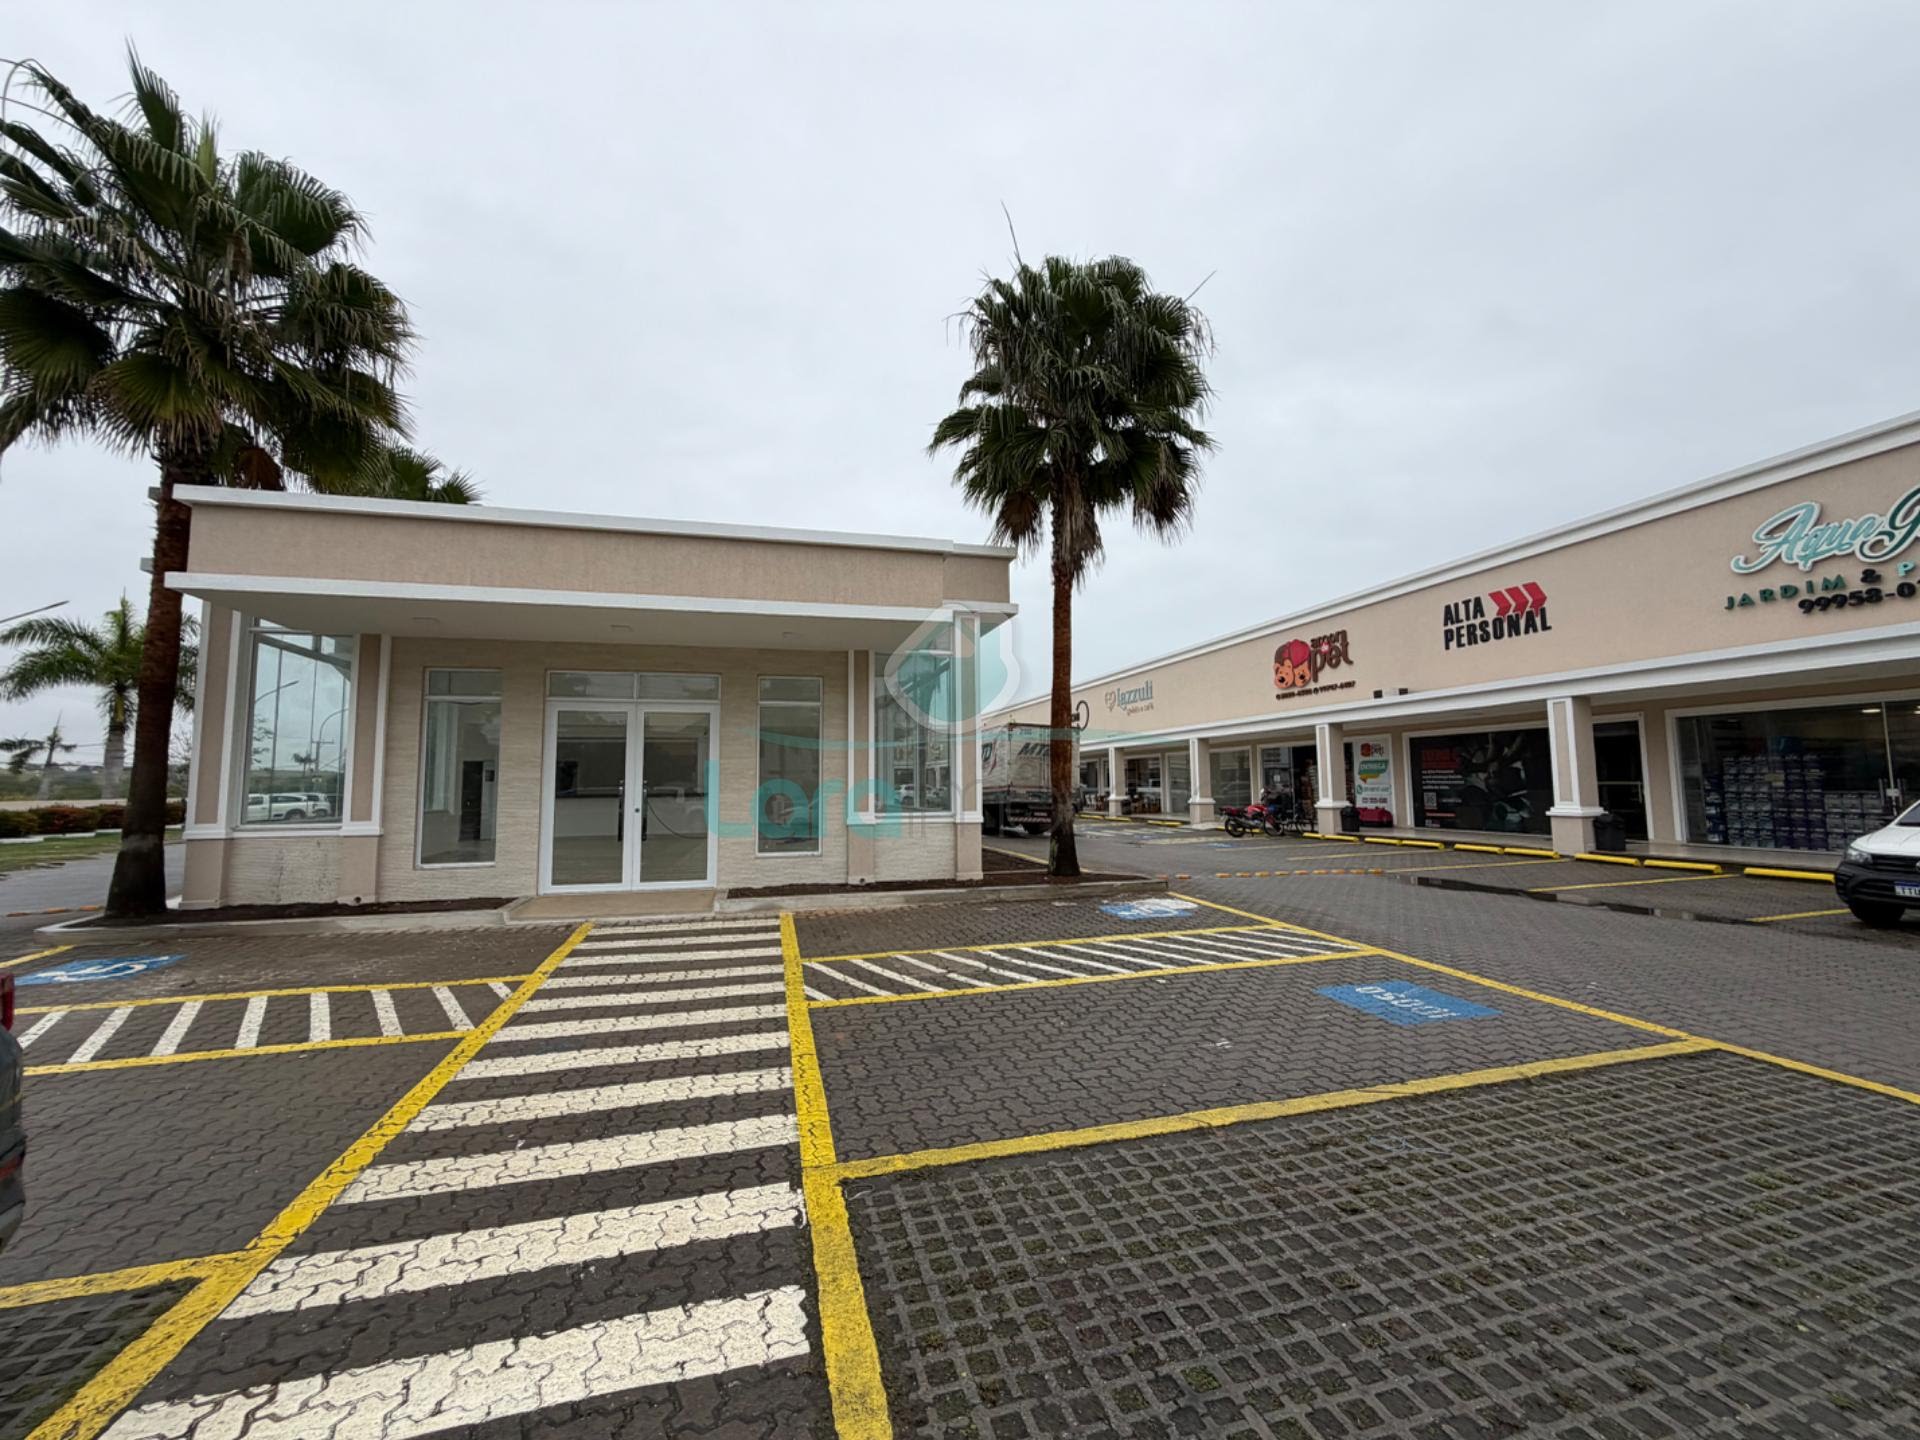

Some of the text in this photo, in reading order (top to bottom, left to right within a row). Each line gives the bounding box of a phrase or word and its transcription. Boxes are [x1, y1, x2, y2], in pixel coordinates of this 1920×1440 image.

[1725, 574, 1847, 610] JARDIM
[1443, 596, 1485, 628] ALTA
[1443, 607, 1552, 650] PERSONAL
